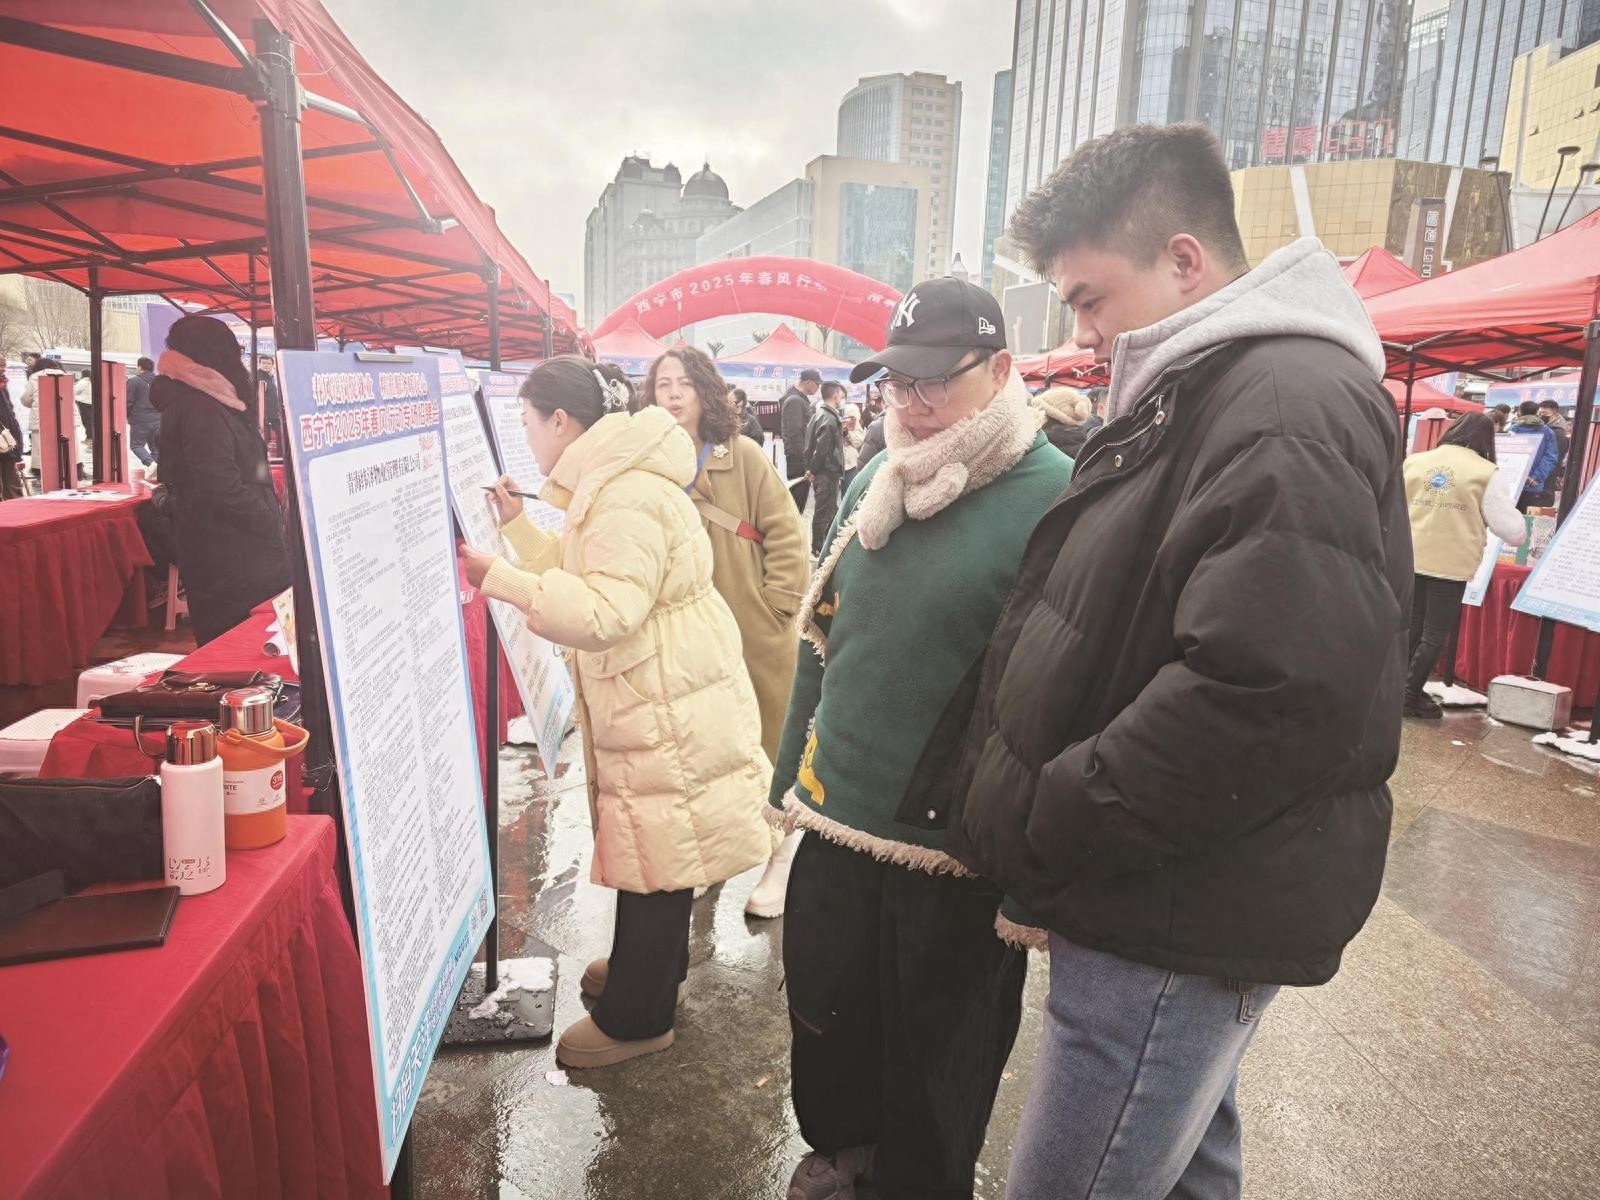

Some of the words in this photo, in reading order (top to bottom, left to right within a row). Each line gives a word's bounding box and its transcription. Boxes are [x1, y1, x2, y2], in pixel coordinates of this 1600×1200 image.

[301, 400, 439, 451] 西宁市2025年春风行动专场招聘会
